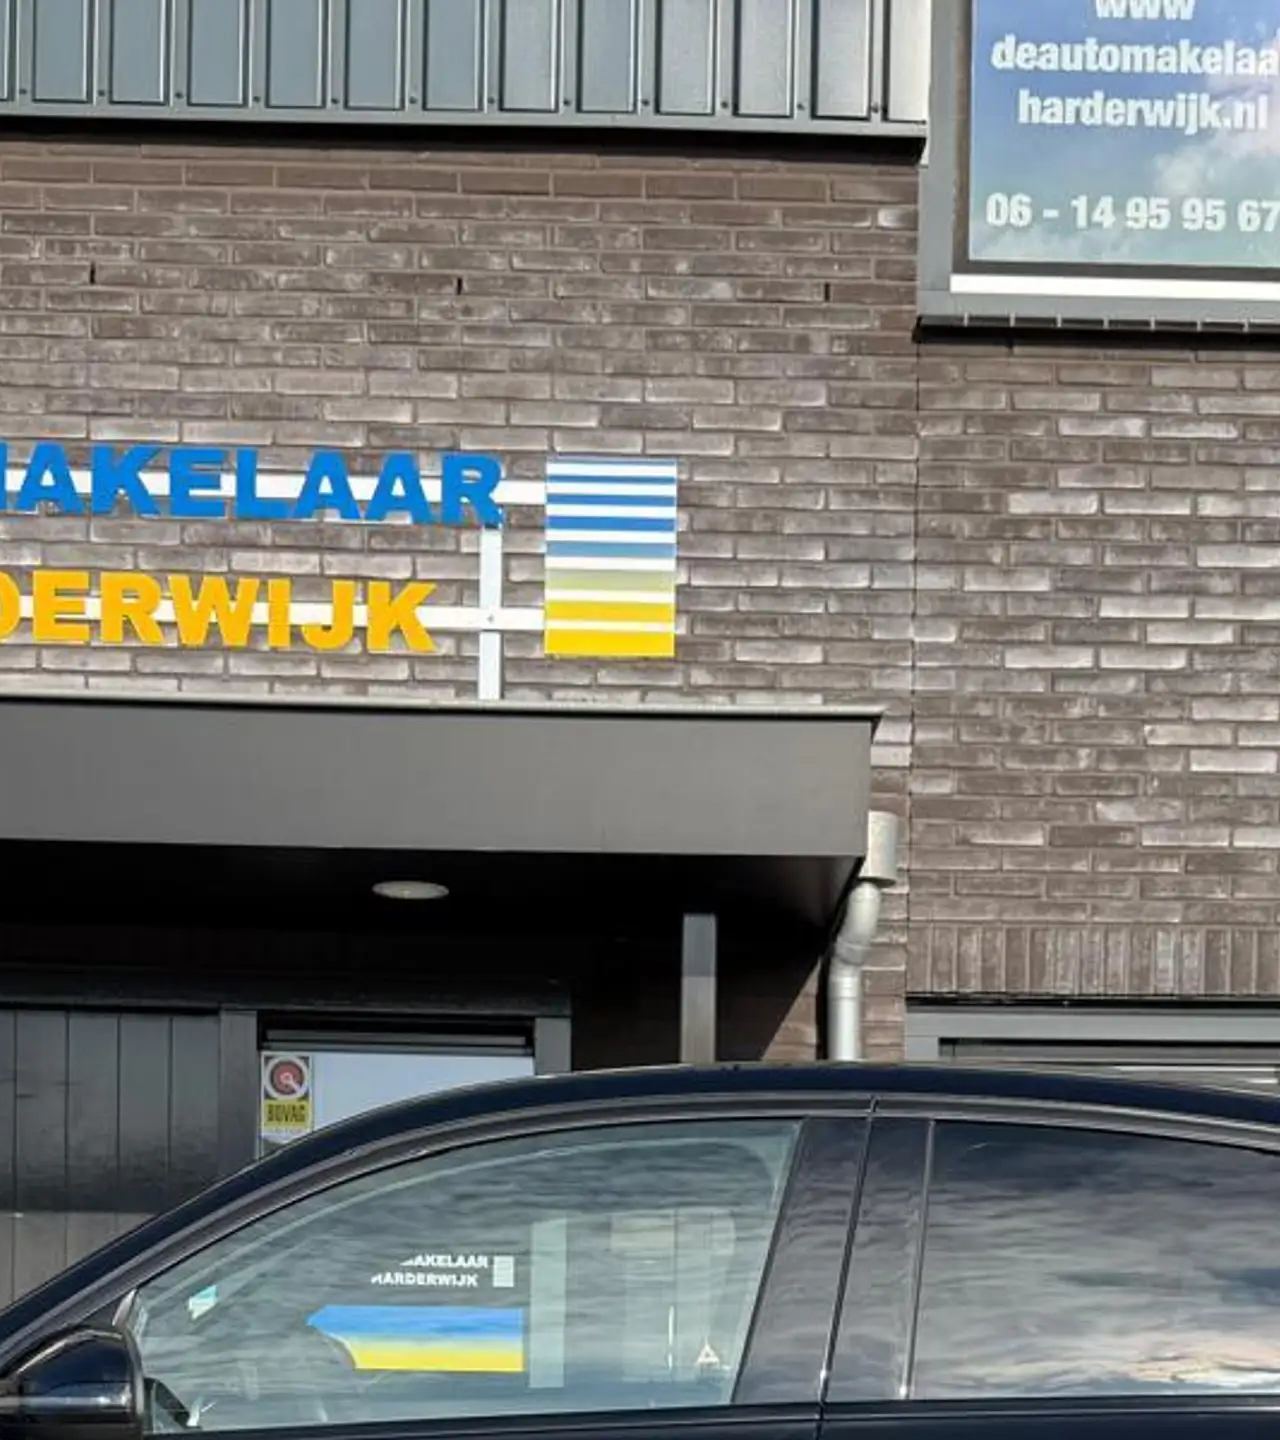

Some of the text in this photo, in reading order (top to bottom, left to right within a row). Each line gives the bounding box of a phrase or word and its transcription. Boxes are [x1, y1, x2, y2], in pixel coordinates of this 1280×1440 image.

[1018, 89, 1268, 136] harderwijk.nl
[986, 192, 1032, 227] 06
[1070, 194, 1117, 230] 14
[1124, 196, 1171, 230] 95
[1179, 196, 1227, 232] 95
